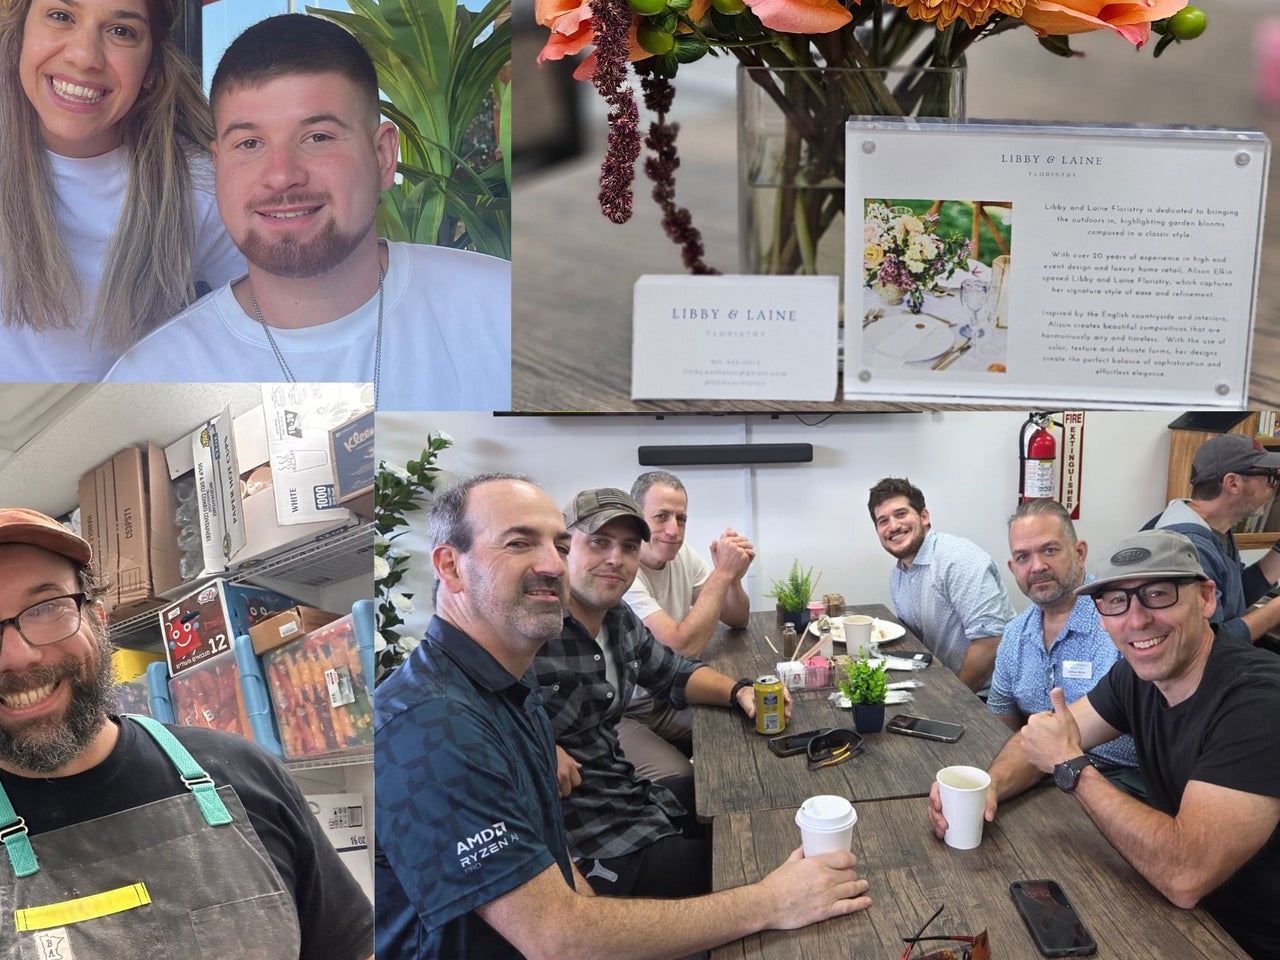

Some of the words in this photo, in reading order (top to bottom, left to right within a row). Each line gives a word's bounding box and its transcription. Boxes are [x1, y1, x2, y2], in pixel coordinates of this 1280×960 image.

[1001, 154, 1039, 164] LIBBY
[1046, 155, 1055, 164] &
[1061, 156, 1103, 166] LAINE
[672, 308, 720, 320] LIBBY
[728, 309, 738, 319] &
[747, 309, 797, 322] LAINE
[1065, 414, 1082, 424] FIRE
[1066, 426, 1077, 509] EXTINGUISHER
[289, 487, 299, 513] WHITE
[316, 486, 328, 509] 1000
[208, 634, 228, 653] 12
[457, 828, 495, 856] AMD
[460, 837, 508, 868] RYZEN
[47, 938, 53, 948] B
[48, 947, 56, 958] A
